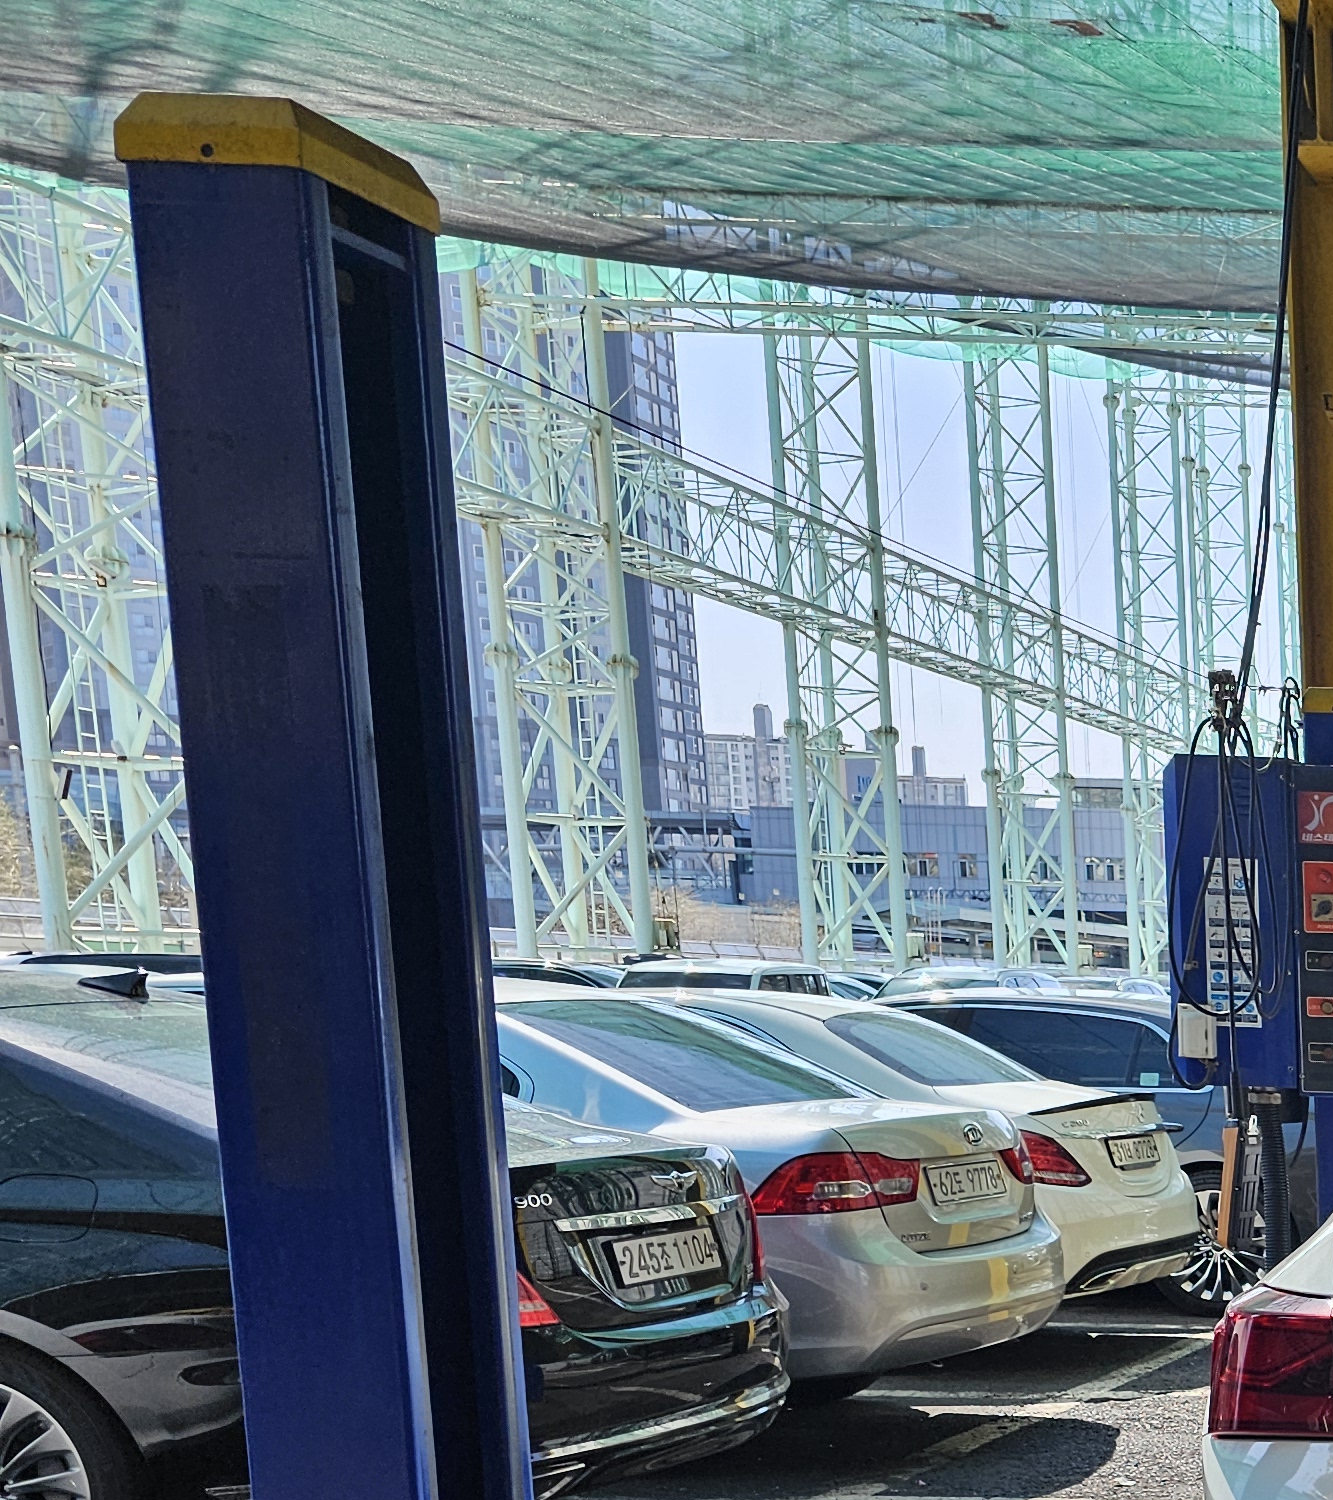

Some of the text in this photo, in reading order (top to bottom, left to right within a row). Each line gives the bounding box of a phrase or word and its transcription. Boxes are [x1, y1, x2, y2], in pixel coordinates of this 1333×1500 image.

[938, 1165, 998, 1196] 62도 9778
[622, 1233, 715, 1279] 245조 1104
